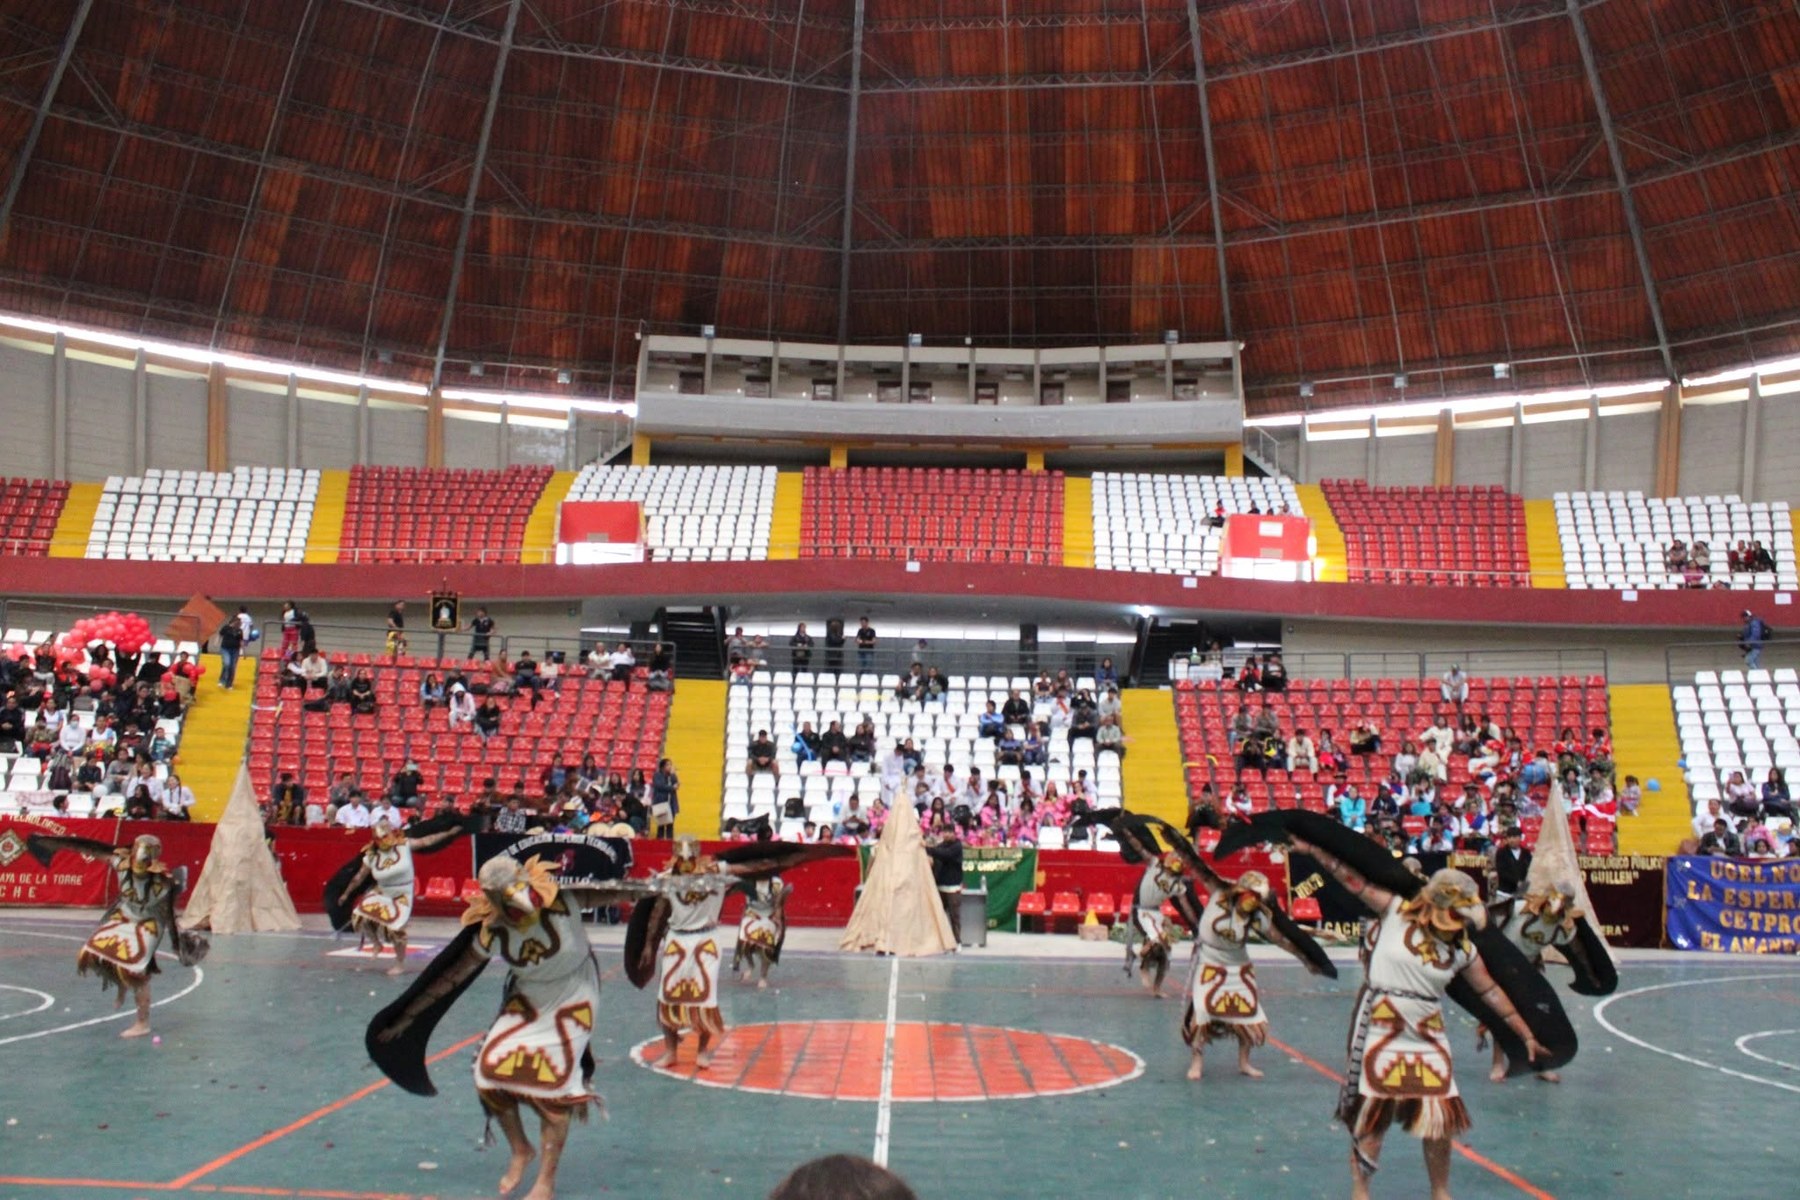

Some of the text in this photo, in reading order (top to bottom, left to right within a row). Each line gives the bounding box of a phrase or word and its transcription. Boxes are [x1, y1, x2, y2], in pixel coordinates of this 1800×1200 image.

[20, 874, 32, 883] DE
[35, 875, 47, 884] LA
[53, 874, 83, 886] TORRE
[1711, 861, 1766, 883] UGEL
[1687, 880, 1800, 909] LA ESPER
[1701, 931, 1726, 953] EL
